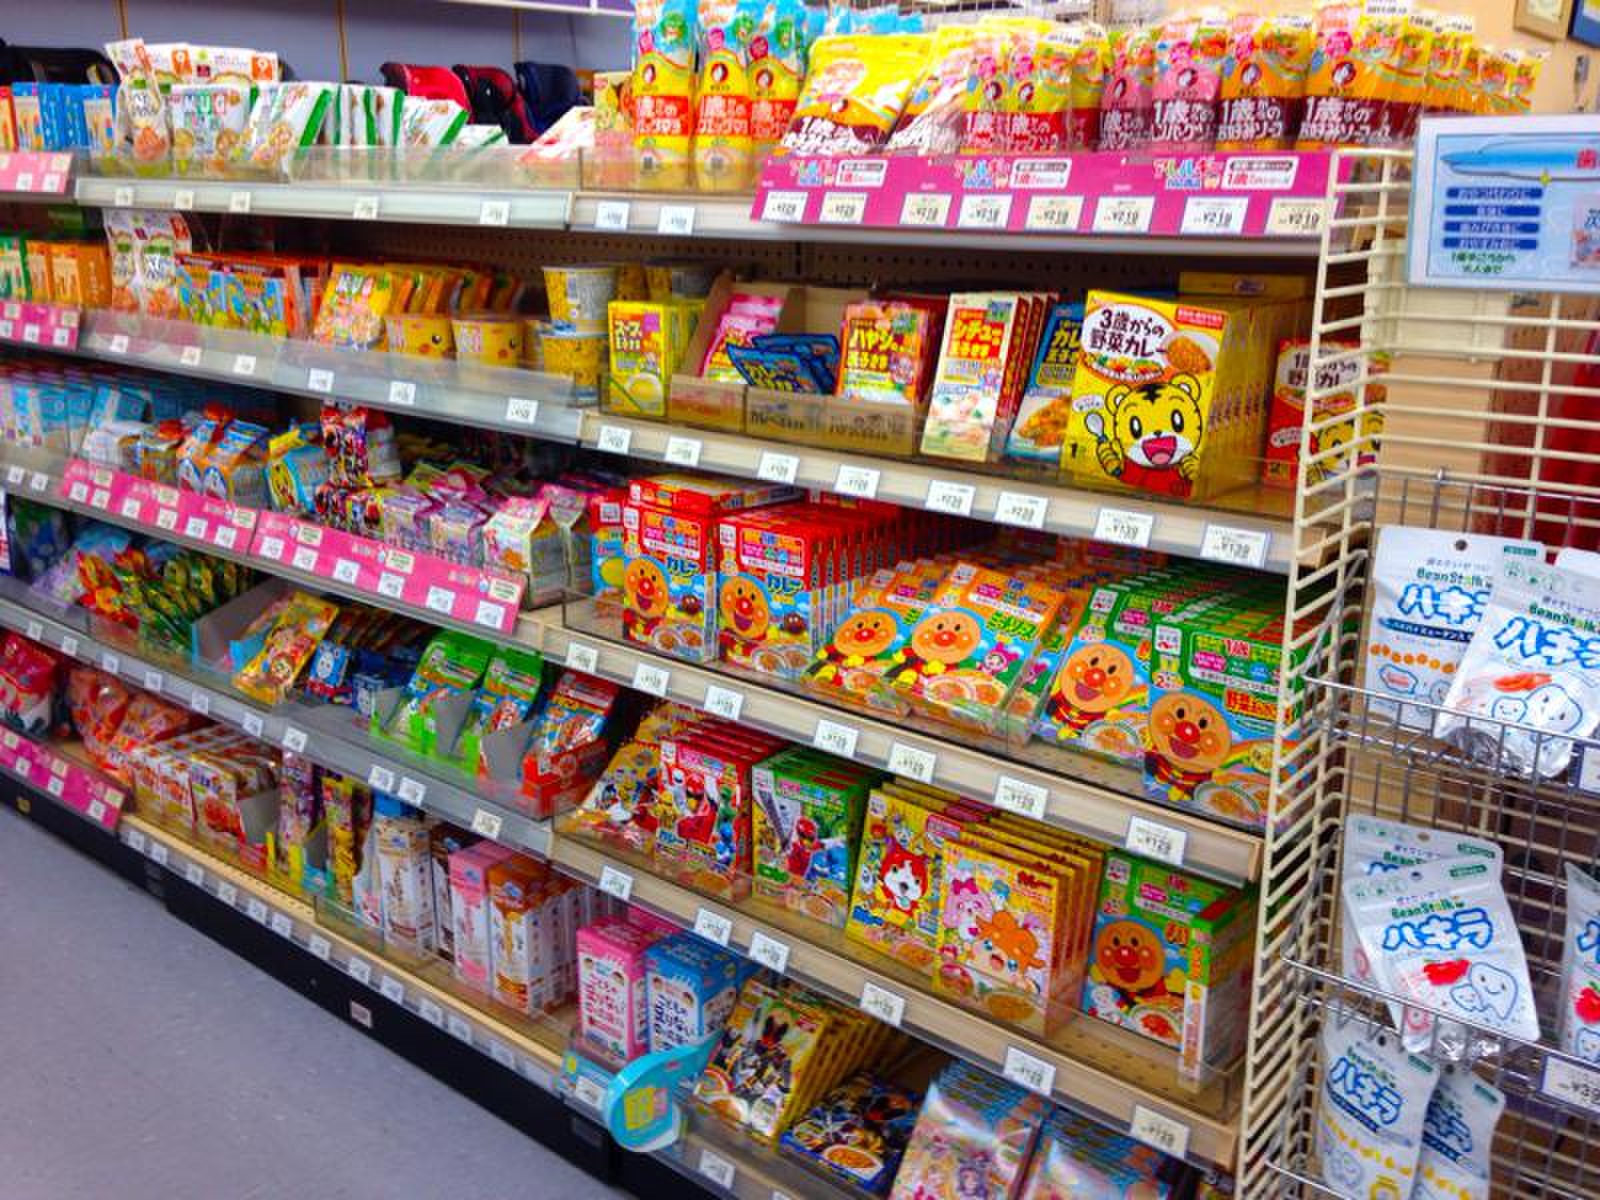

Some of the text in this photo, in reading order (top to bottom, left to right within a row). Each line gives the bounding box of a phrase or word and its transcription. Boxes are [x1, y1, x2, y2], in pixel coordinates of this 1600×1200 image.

[1099, 308, 1165, 337] 3歳からの
[1090, 327, 1169, 358] 野菜カレー
[1382, 907, 1494, 951] ハキラ
